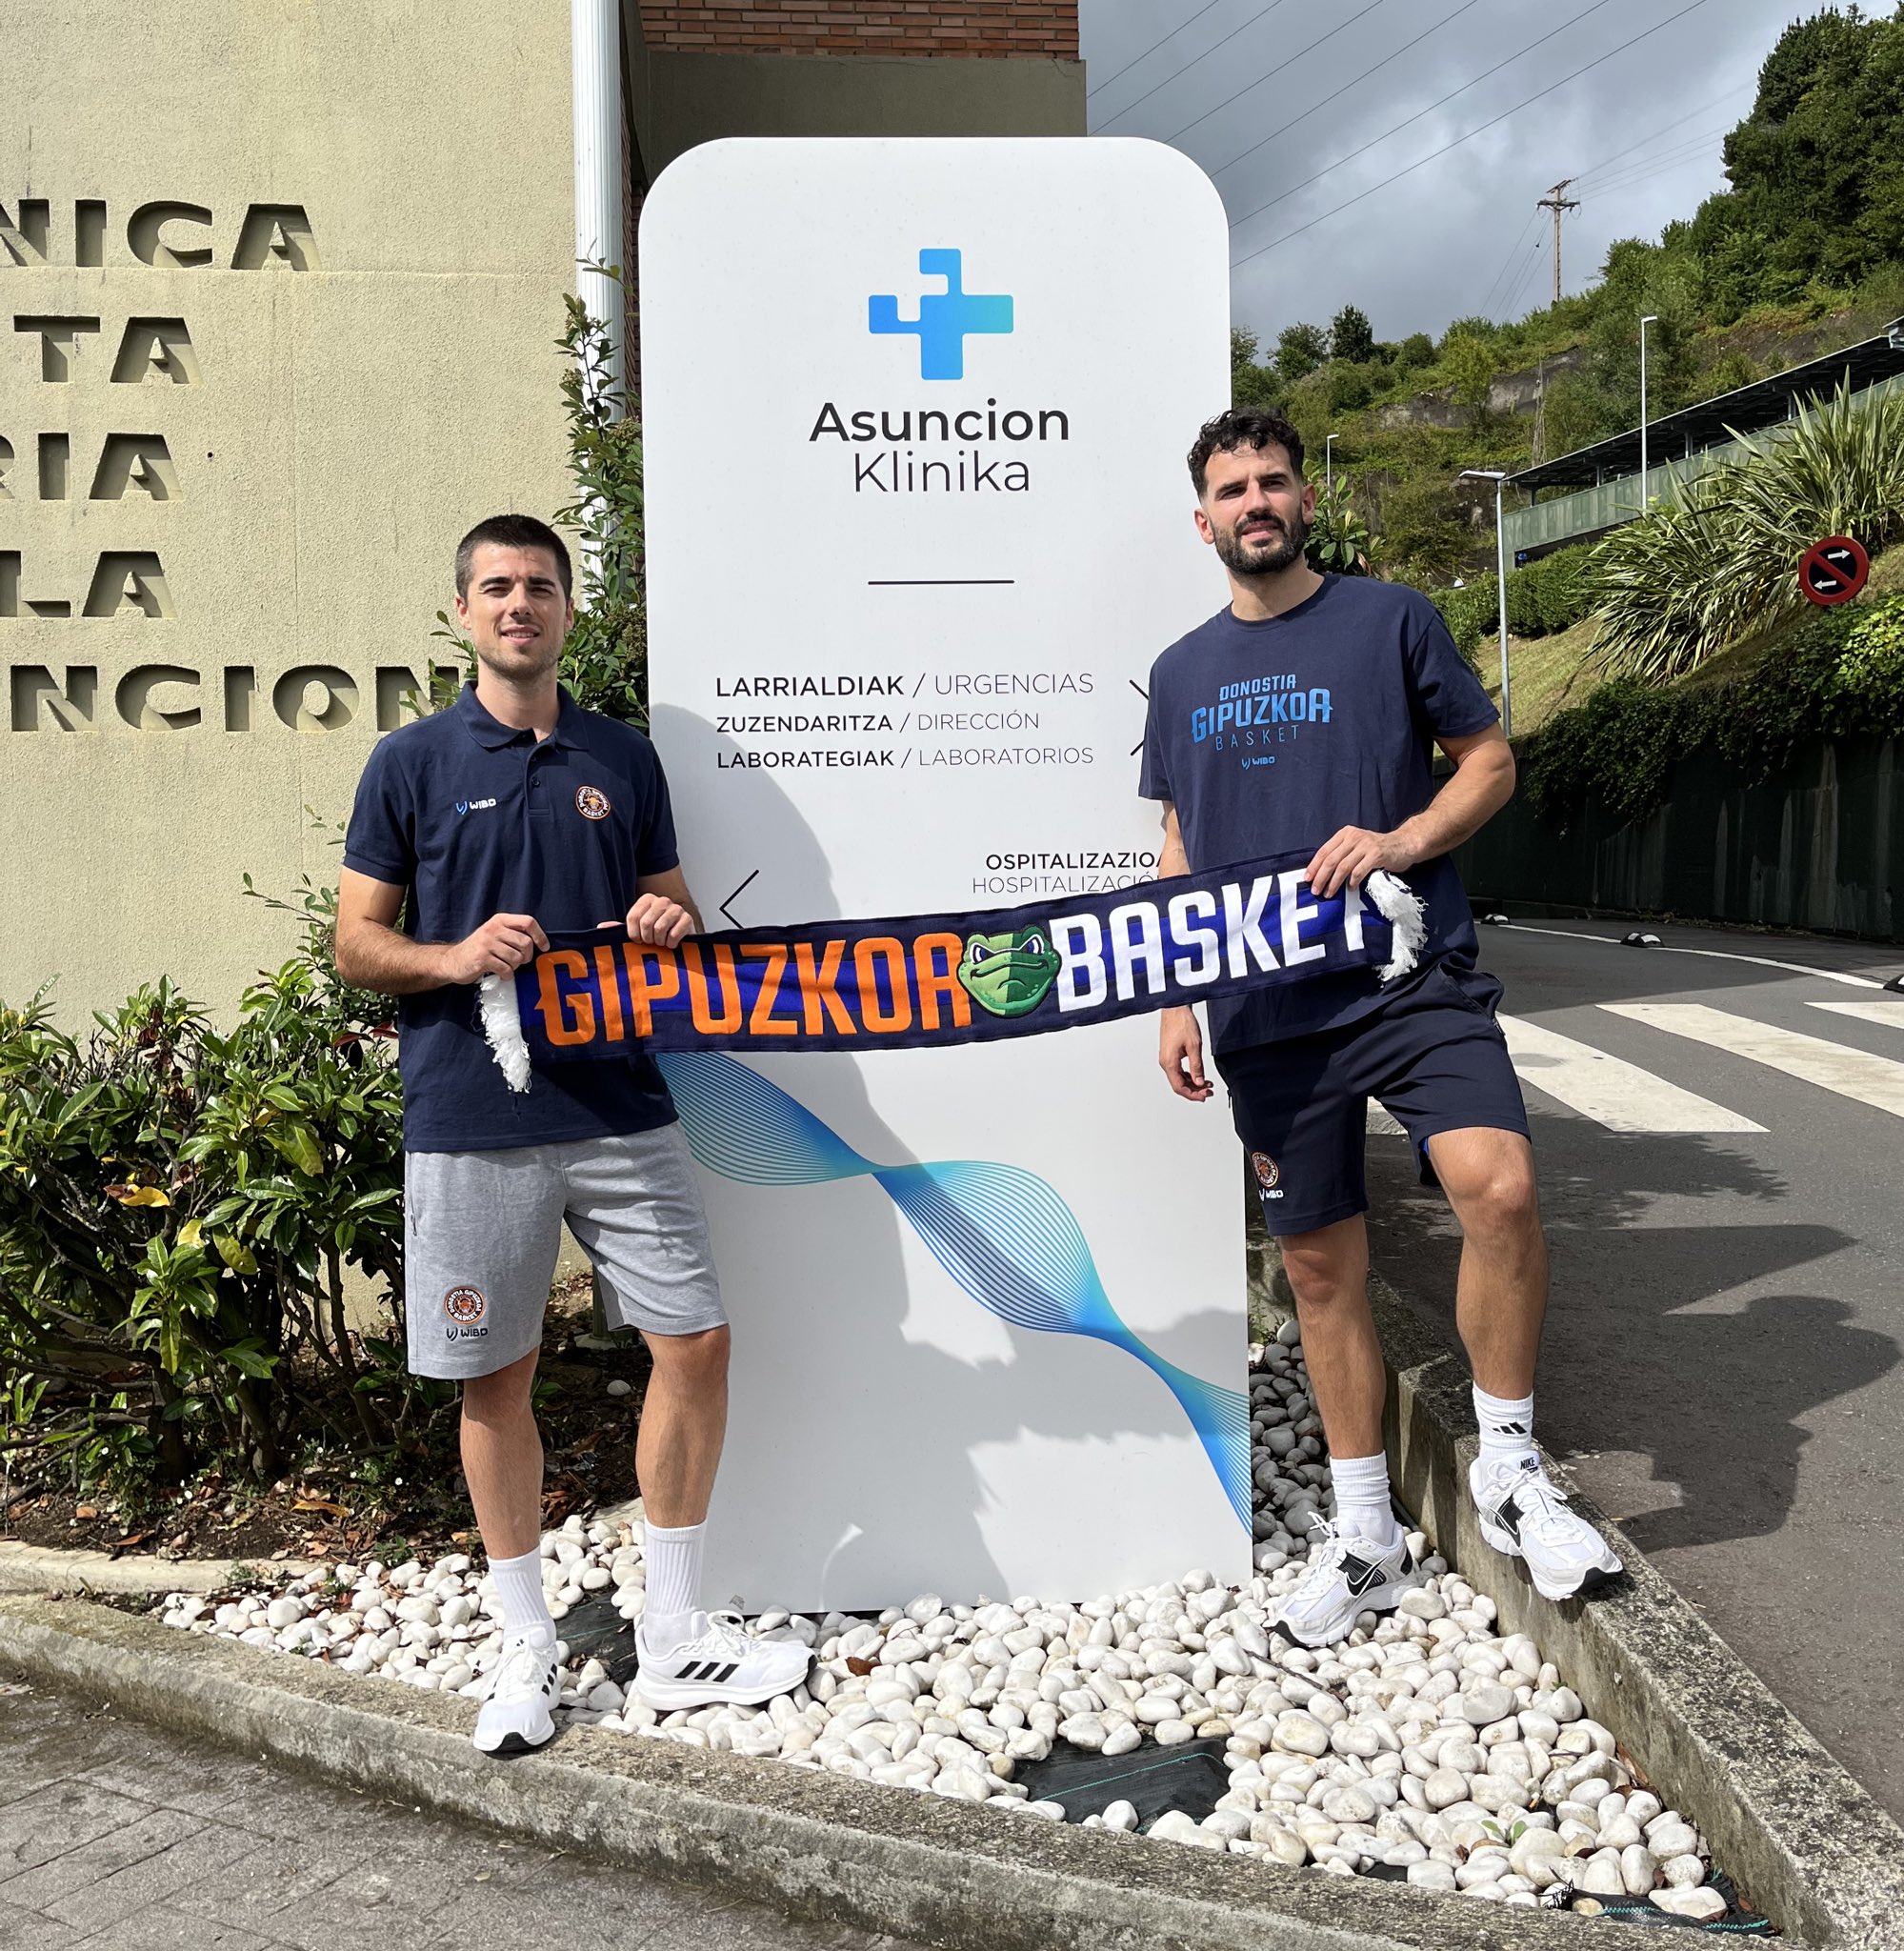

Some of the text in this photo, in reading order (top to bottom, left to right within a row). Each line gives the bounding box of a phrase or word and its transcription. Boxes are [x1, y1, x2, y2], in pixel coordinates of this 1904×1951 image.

[13, 315, 203, 384] TA
[809, 397, 1069, 441] Asuncion
[0, 432, 184, 500] IA
[854, 450, 1030, 493] Klinika
[716, 673, 1093, 698] LARRIALDIAK / URGENCIAS
[1219, 674, 1296, 701] DONOSTIA
[716, 709, 1039, 734] ZUZENDARITZA / DIRECCIÓN
[1191, 688, 1333, 743] GIPUZKOA
[1215, 724, 1299, 751] BASKET
[717, 747, 1093, 769] LABORATEGIAK / LABORATORIOS
[1252, 755, 1275, 765] WIBO
[469, 798, 497, 810] WIBO
[534, 932, 972, 1046] GIPUZKOA
[460, 1327, 489, 1338] WIBO
[1519, 1457, 1535, 1470] NIKE
